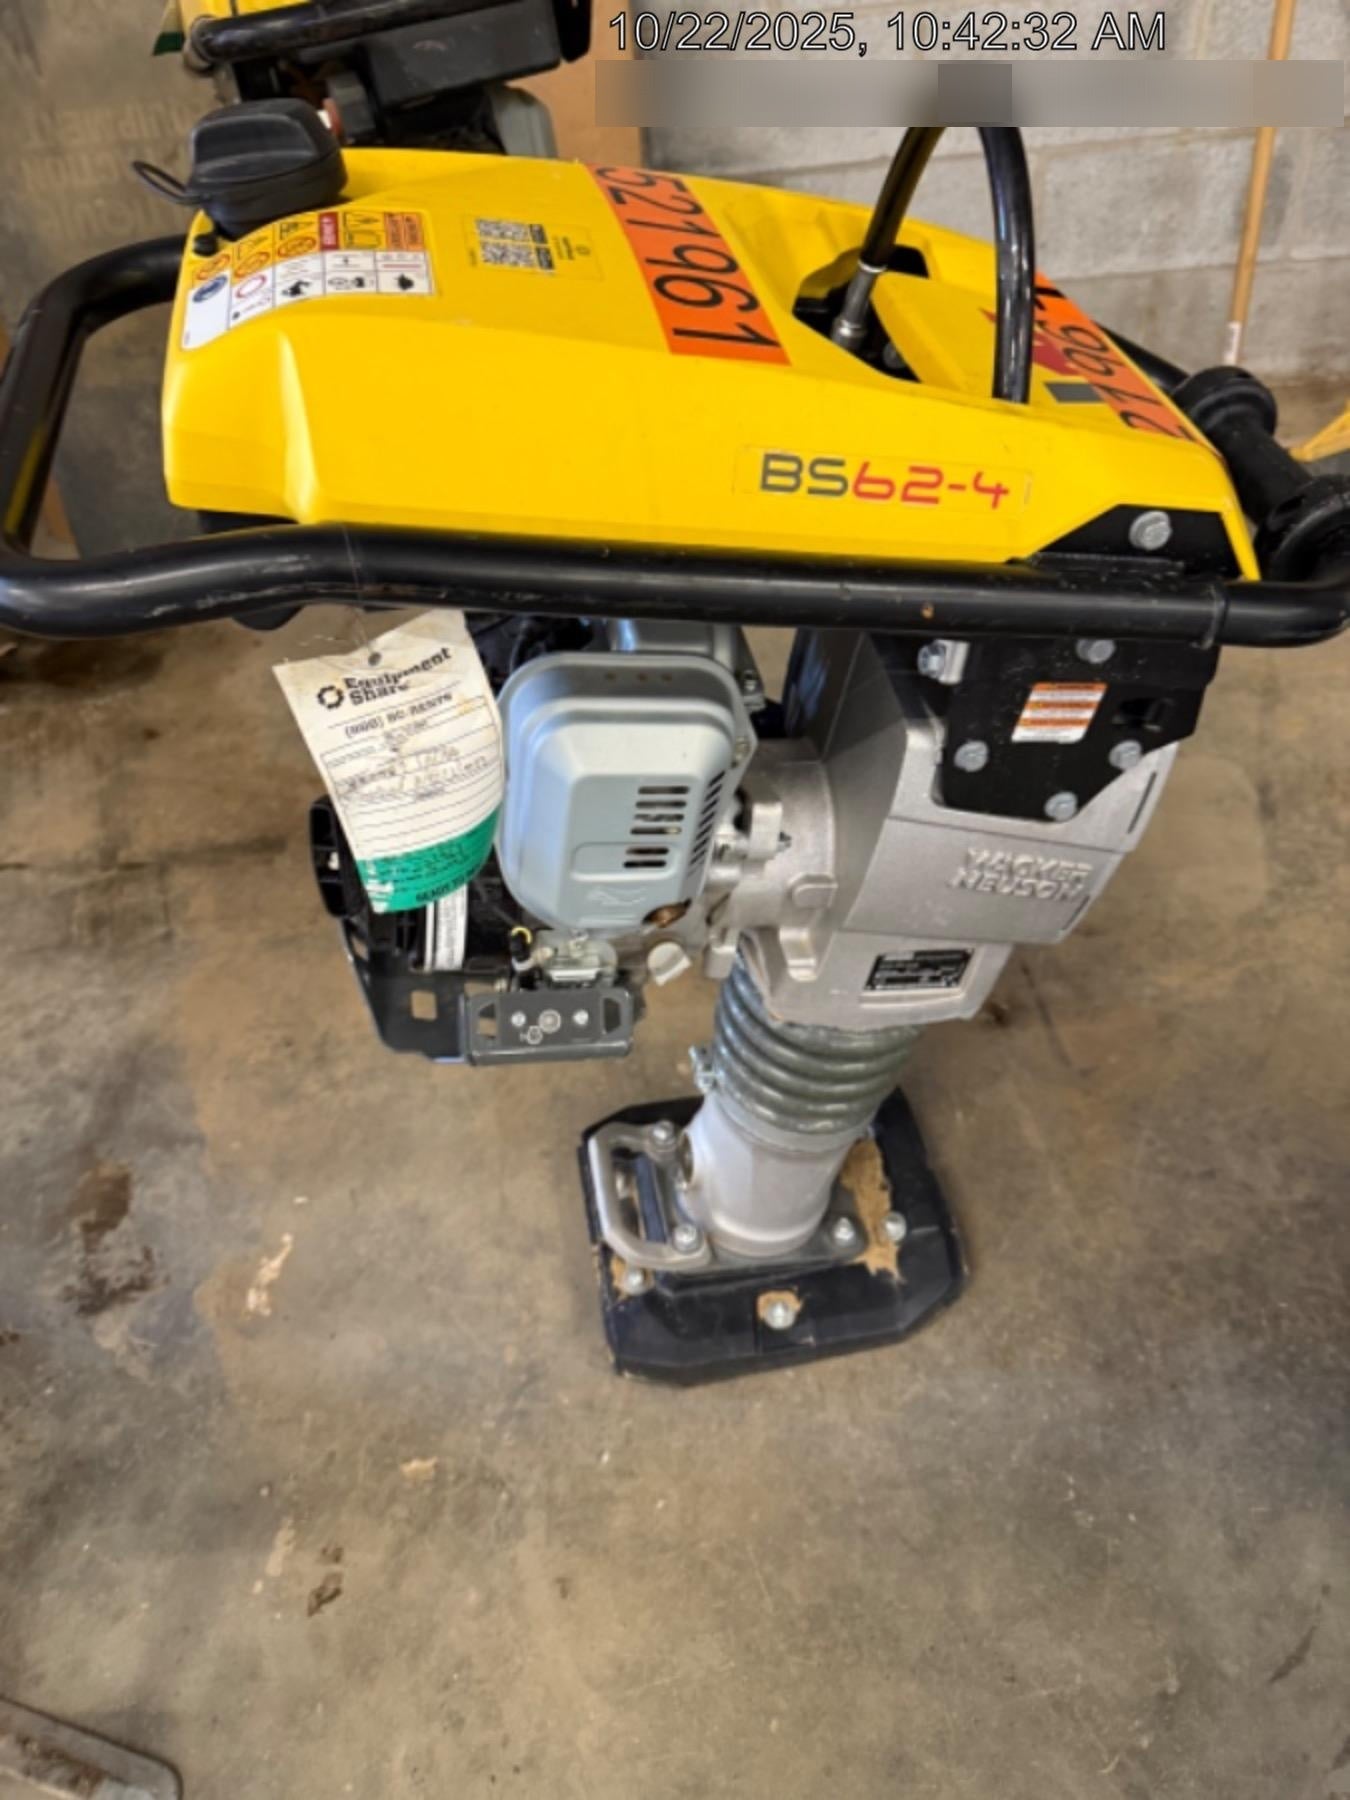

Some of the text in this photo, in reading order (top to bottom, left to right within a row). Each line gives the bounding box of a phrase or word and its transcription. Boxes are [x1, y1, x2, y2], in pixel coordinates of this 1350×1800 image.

[595, 166, 784, 349] 521961
[760, 452, 1010, 510] BS62-4
[342, 647, 452, 692] Equipment
[349, 681, 411, 706] Share
[950, 867, 1086, 900] NEUSON
[966, 848, 1092, 881] WACKER
